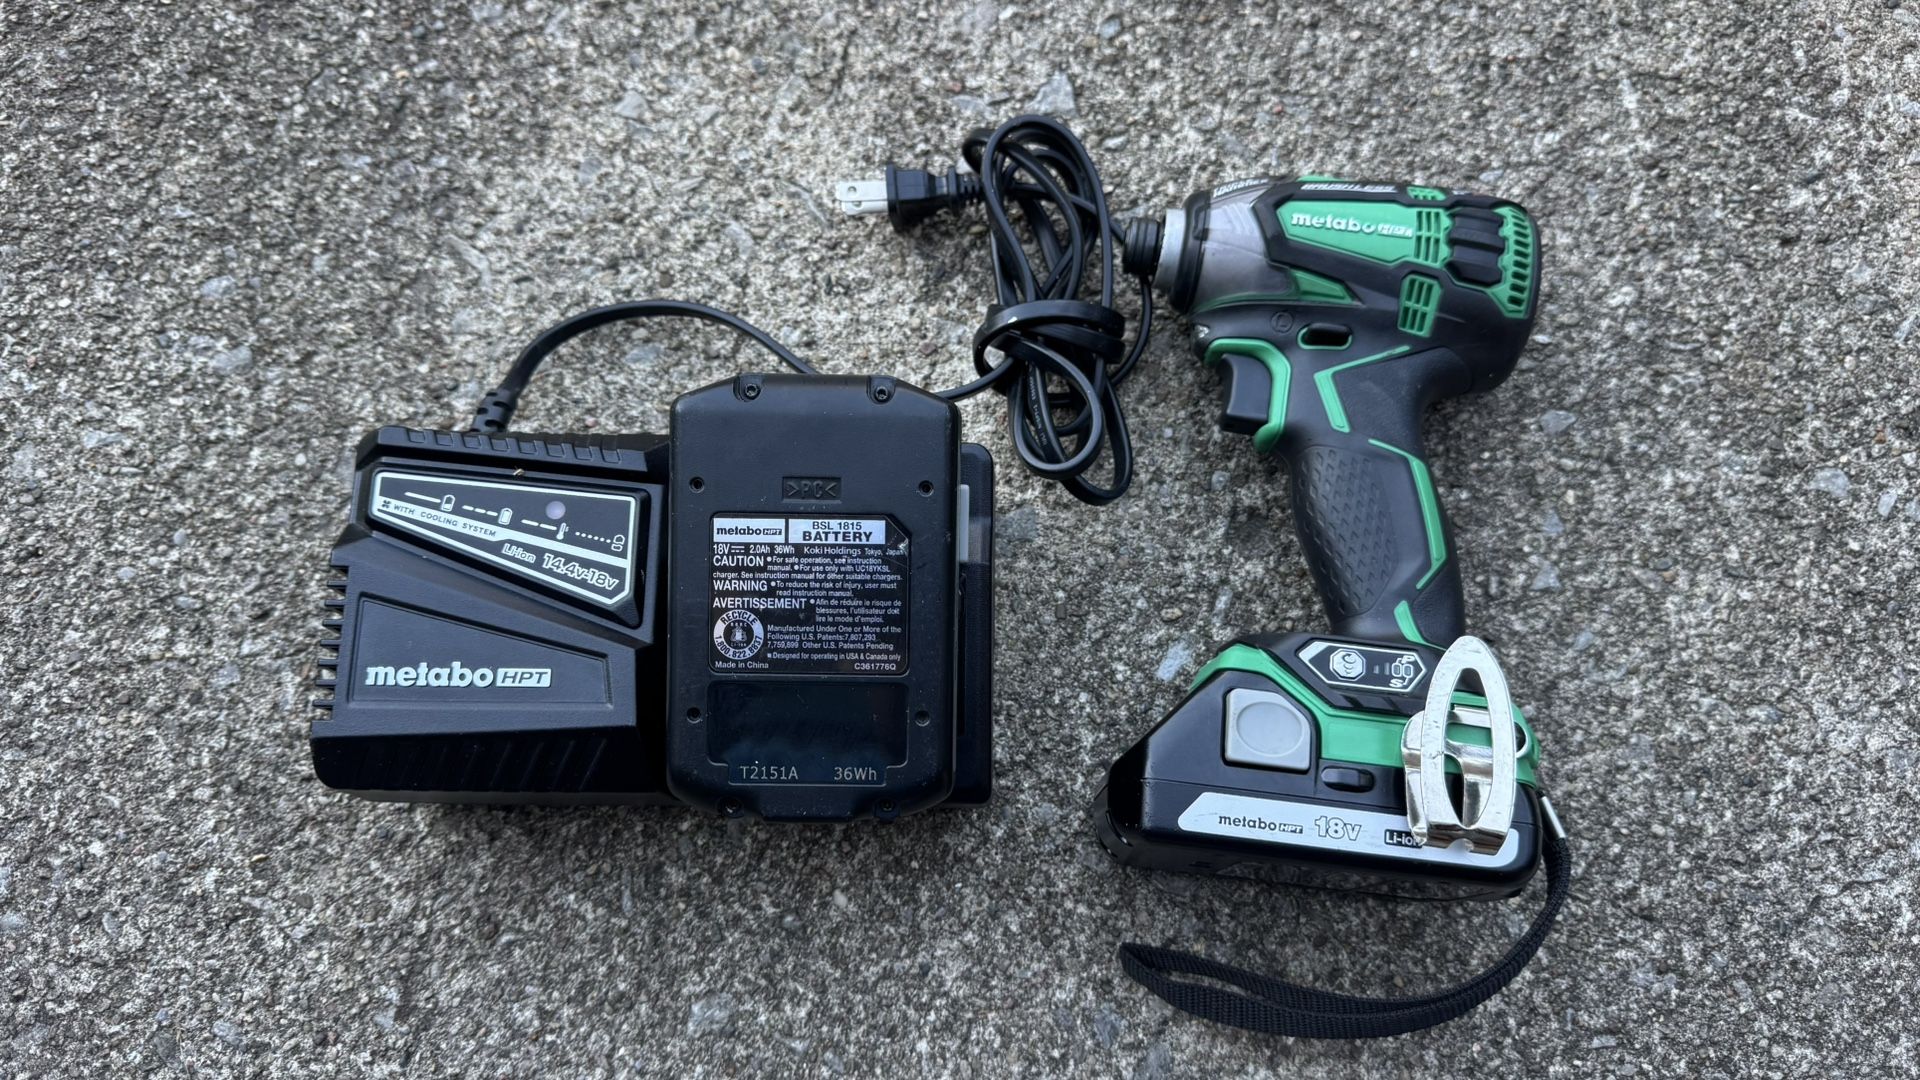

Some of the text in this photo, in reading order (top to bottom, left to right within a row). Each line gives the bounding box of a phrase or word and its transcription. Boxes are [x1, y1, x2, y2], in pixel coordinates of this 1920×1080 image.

[1291, 213, 1376, 234] metabo
[394, 504, 496, 537] WITH COOLING SYSTEM
[812, 521, 862, 530] BSL 1815
[716, 526, 762, 535] metabo
[803, 531, 872, 542] BATTERY
[501, 543, 537, 564] Li-ion
[713, 544, 730, 554] 18V
[750, 545, 770, 554] 2.0Ah
[774, 545, 795, 554] 36Wh
[804, 546, 823, 554] Koki
[824, 546, 861, 556] Holdings
[713, 555, 764, 567] CAUTION
[800, 557, 832, 565] operation,
[713, 571, 739, 579] charger.
[872, 573, 902, 581] chargers.
[713, 580, 767, 591] WARNING
[843, 582, 863, 590] injury,
[713, 597, 807, 609] AVERTISSEMENT
[720, 611, 757, 625] RECYCLE
[767, 633, 799, 641] Following
[866, 642, 893, 650] Pending
[773, 652, 800, 660] Designed
[811, 653, 838, 661] operating
[889, 653, 901, 661] only
[1401, 655, 1416, 664] P
[365, 661, 550, 688] metabo HPT
[1389, 679, 1403, 687] S
[740, 766, 877, 781] T2151A 36Wh
[1218, 815, 1277, 831] metabo
[1279, 823, 1303, 834] HPT
